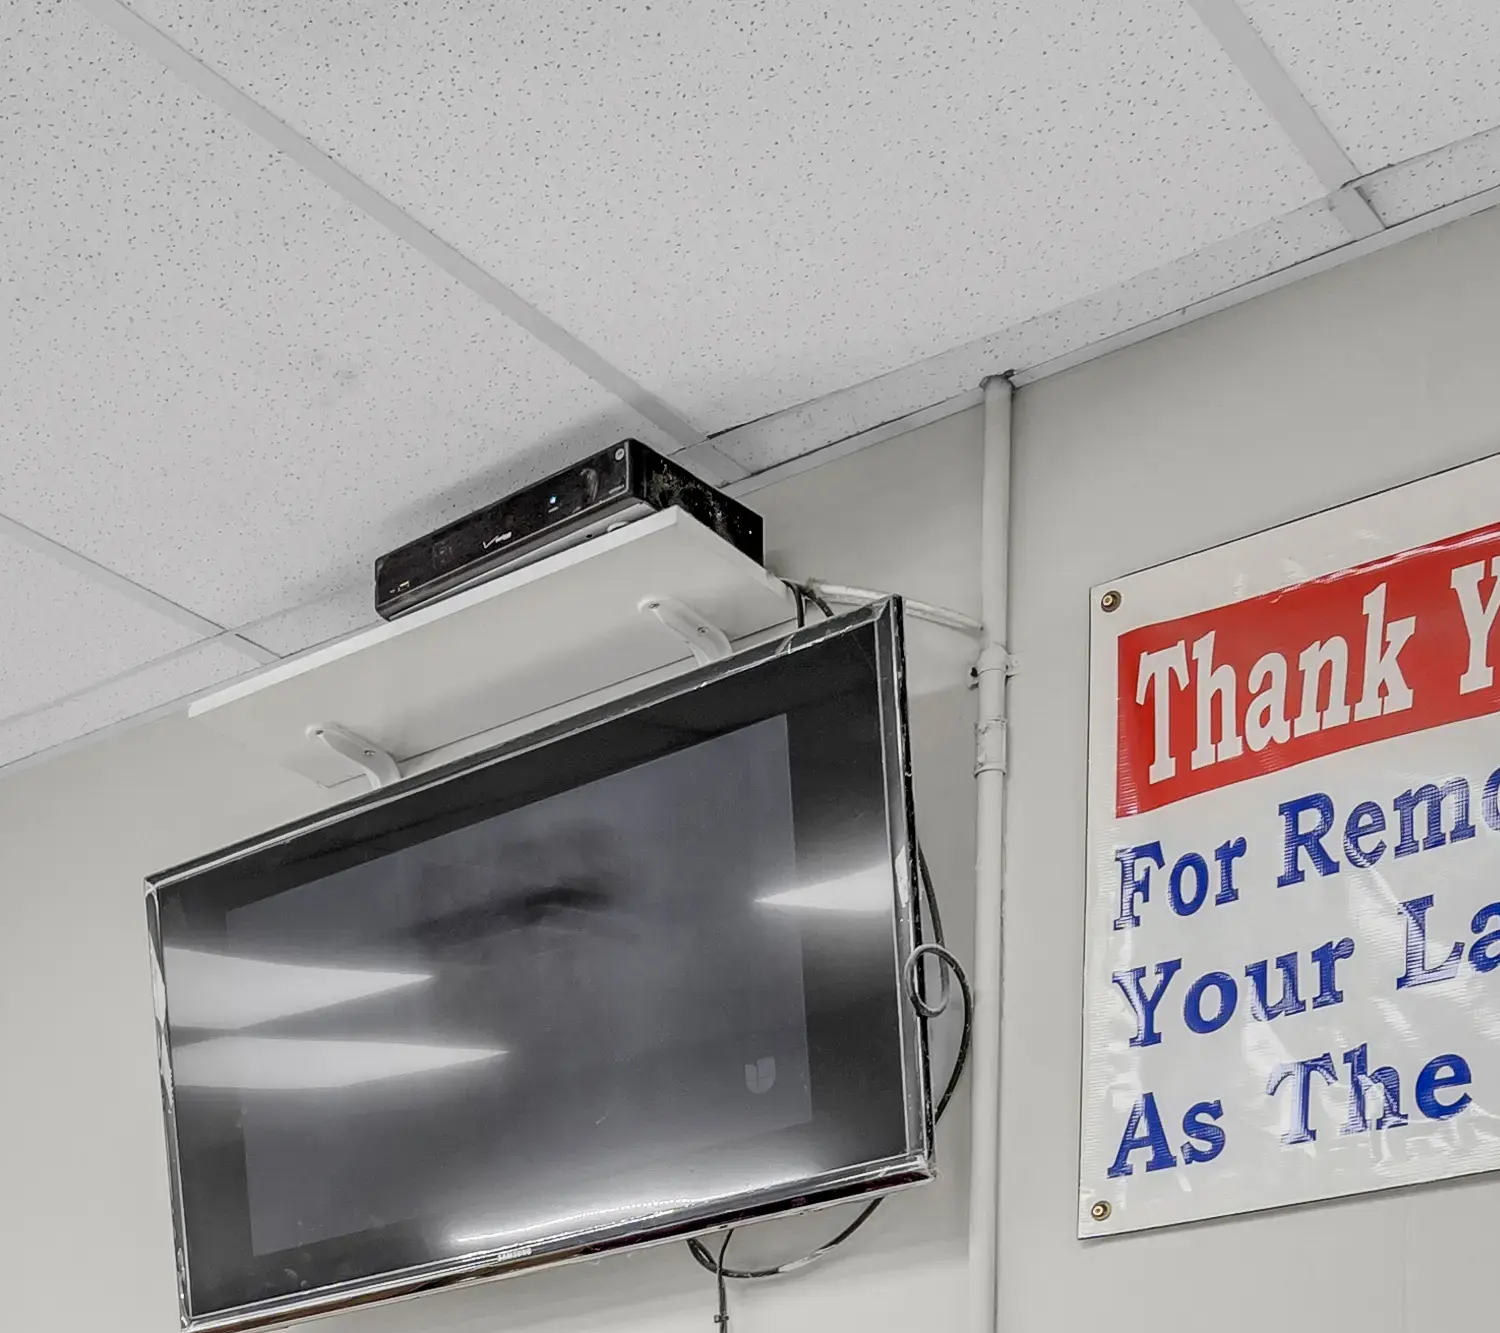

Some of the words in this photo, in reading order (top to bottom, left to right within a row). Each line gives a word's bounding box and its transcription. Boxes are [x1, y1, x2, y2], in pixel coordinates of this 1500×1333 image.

[1138, 597, 1417, 788] Thank
[1114, 834, 1247, 930] For
[1112, 945, 1347, 1050] Your
[1106, 1089, 1227, 1178] As
[1269, 1034, 1473, 1148] The
